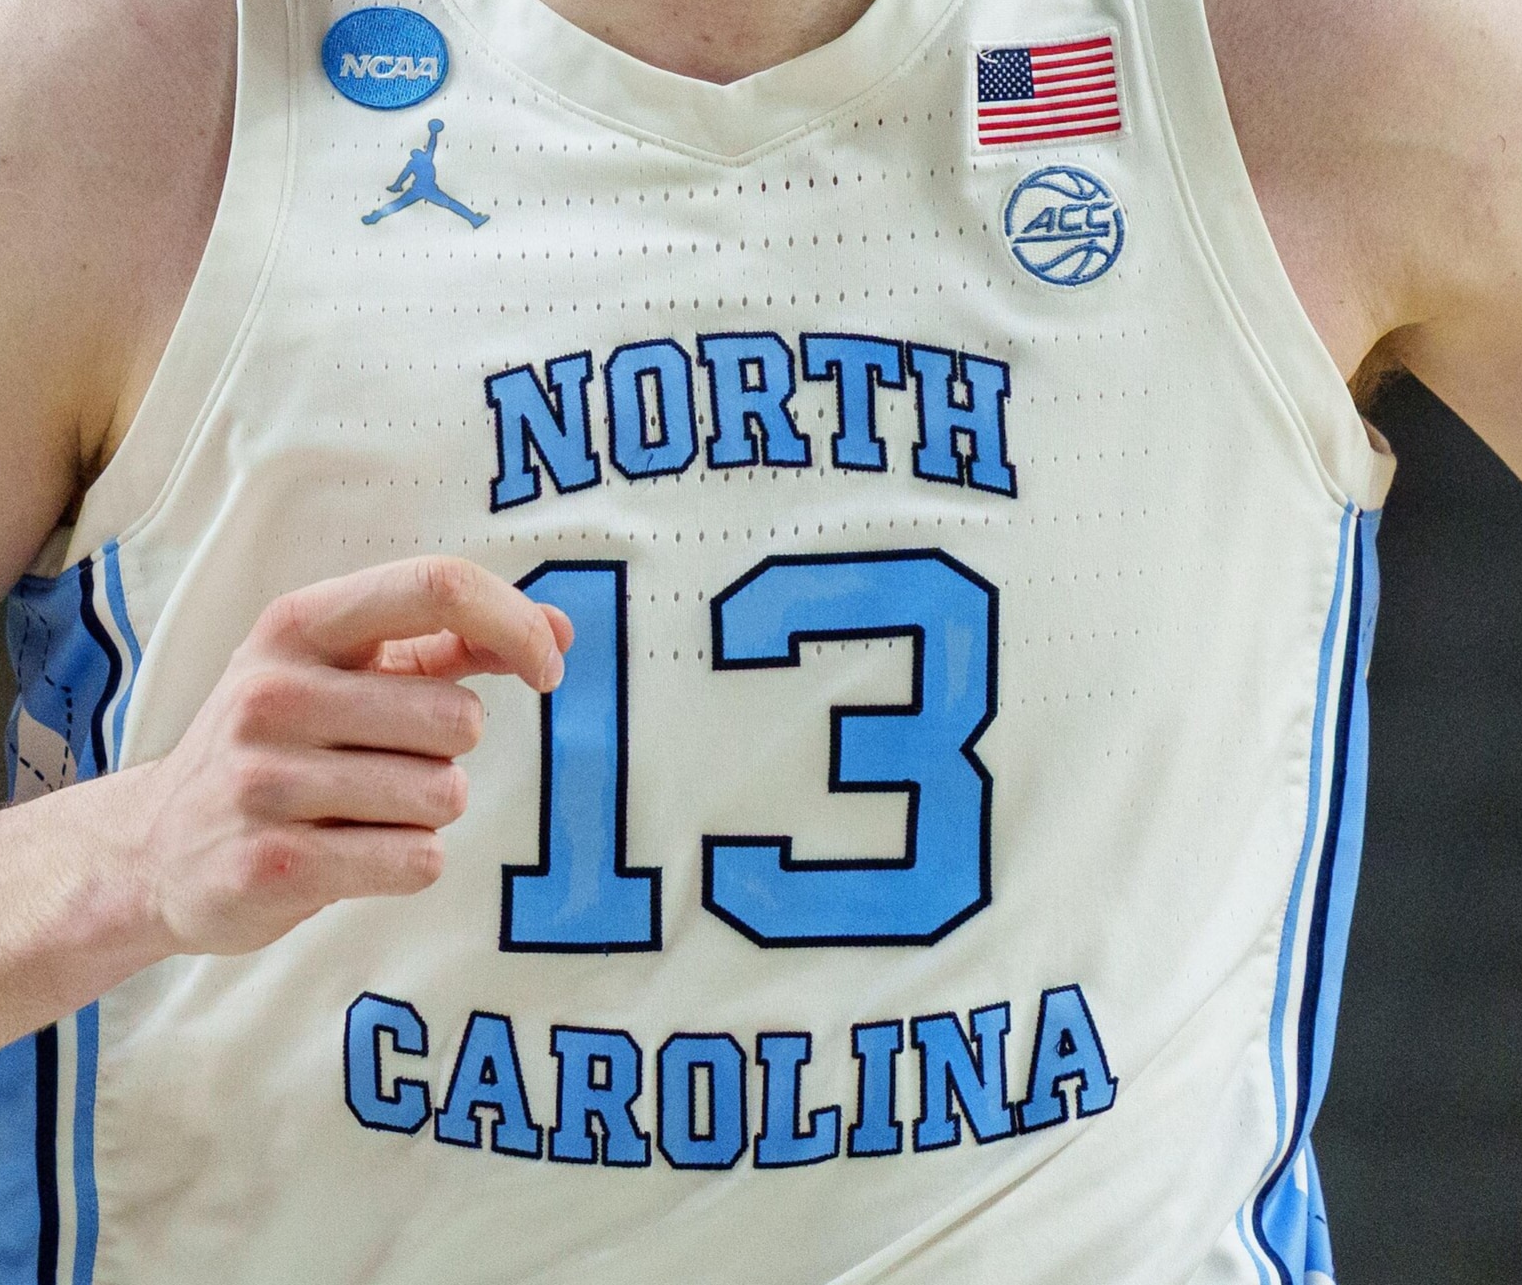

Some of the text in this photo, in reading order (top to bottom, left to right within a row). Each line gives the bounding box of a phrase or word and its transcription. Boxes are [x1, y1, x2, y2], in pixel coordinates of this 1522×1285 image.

[340, 53, 439, 81] NCAA
[1021, 201, 1114, 234] ACC
[486, 331, 1018, 512] NORTH
[499, 548, 999, 953] 13
[343, 983, 1119, 1170] CAROLINA
